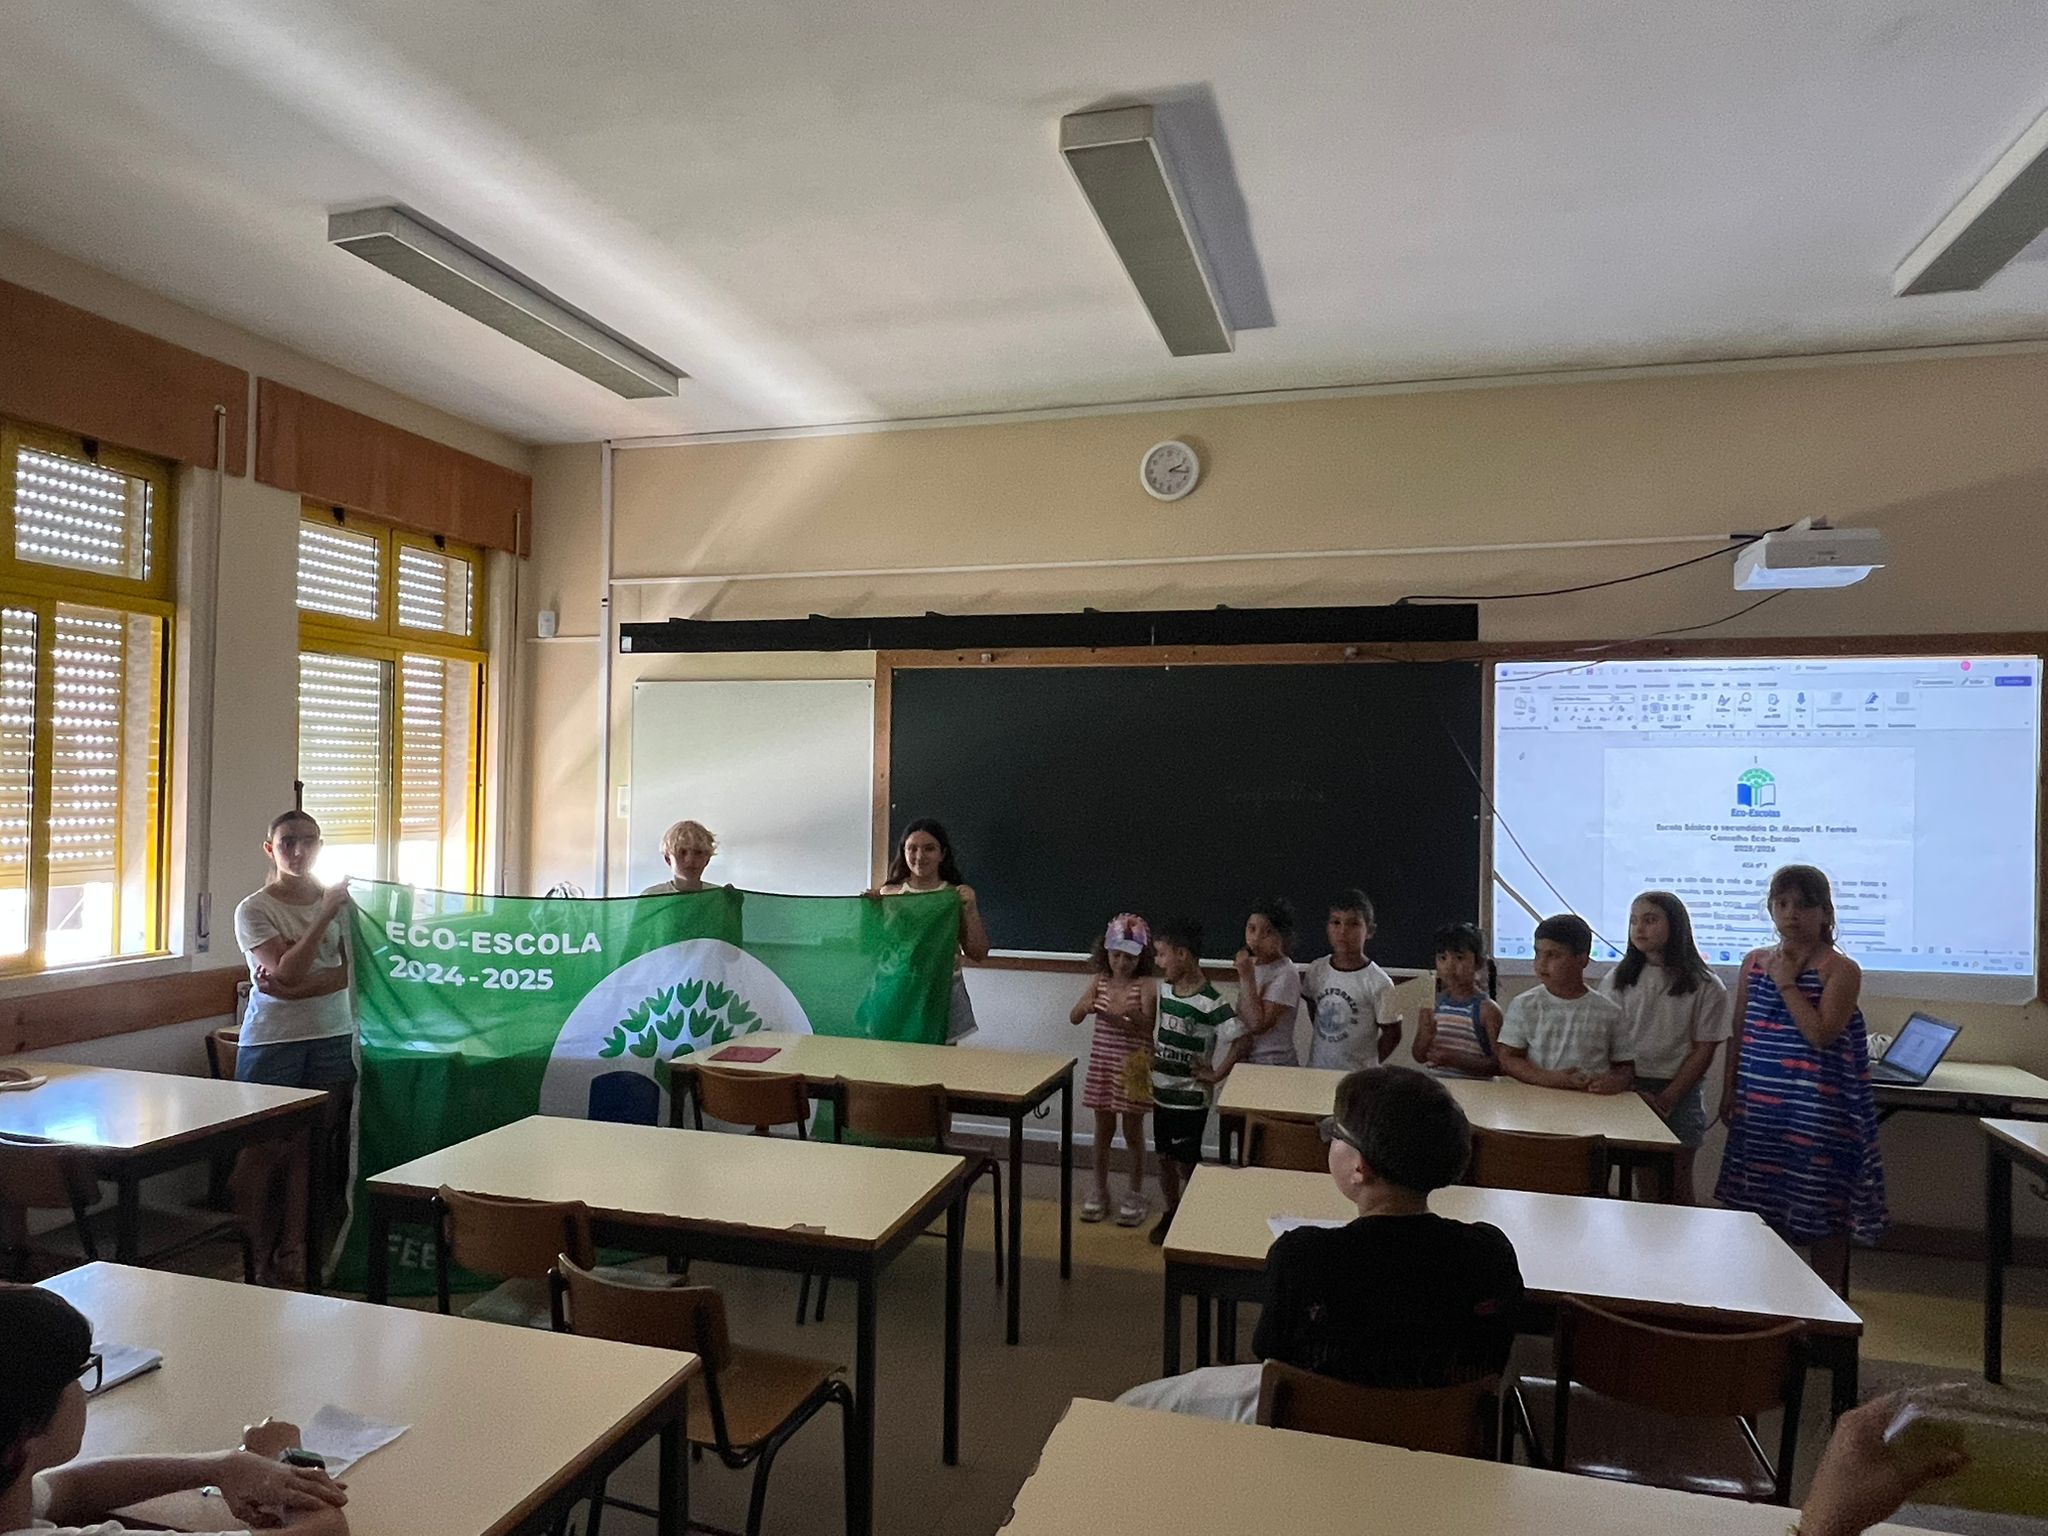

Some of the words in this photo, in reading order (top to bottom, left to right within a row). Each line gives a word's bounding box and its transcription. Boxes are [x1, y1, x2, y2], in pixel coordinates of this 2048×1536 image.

[1730, 807, 1781, 818] Eco-Escolas
[1782, 825, 1814, 833] Manuel
[1825, 825, 1857, 833] Ferreira
[385, 921, 602, 955] ECO-ESCOLA
